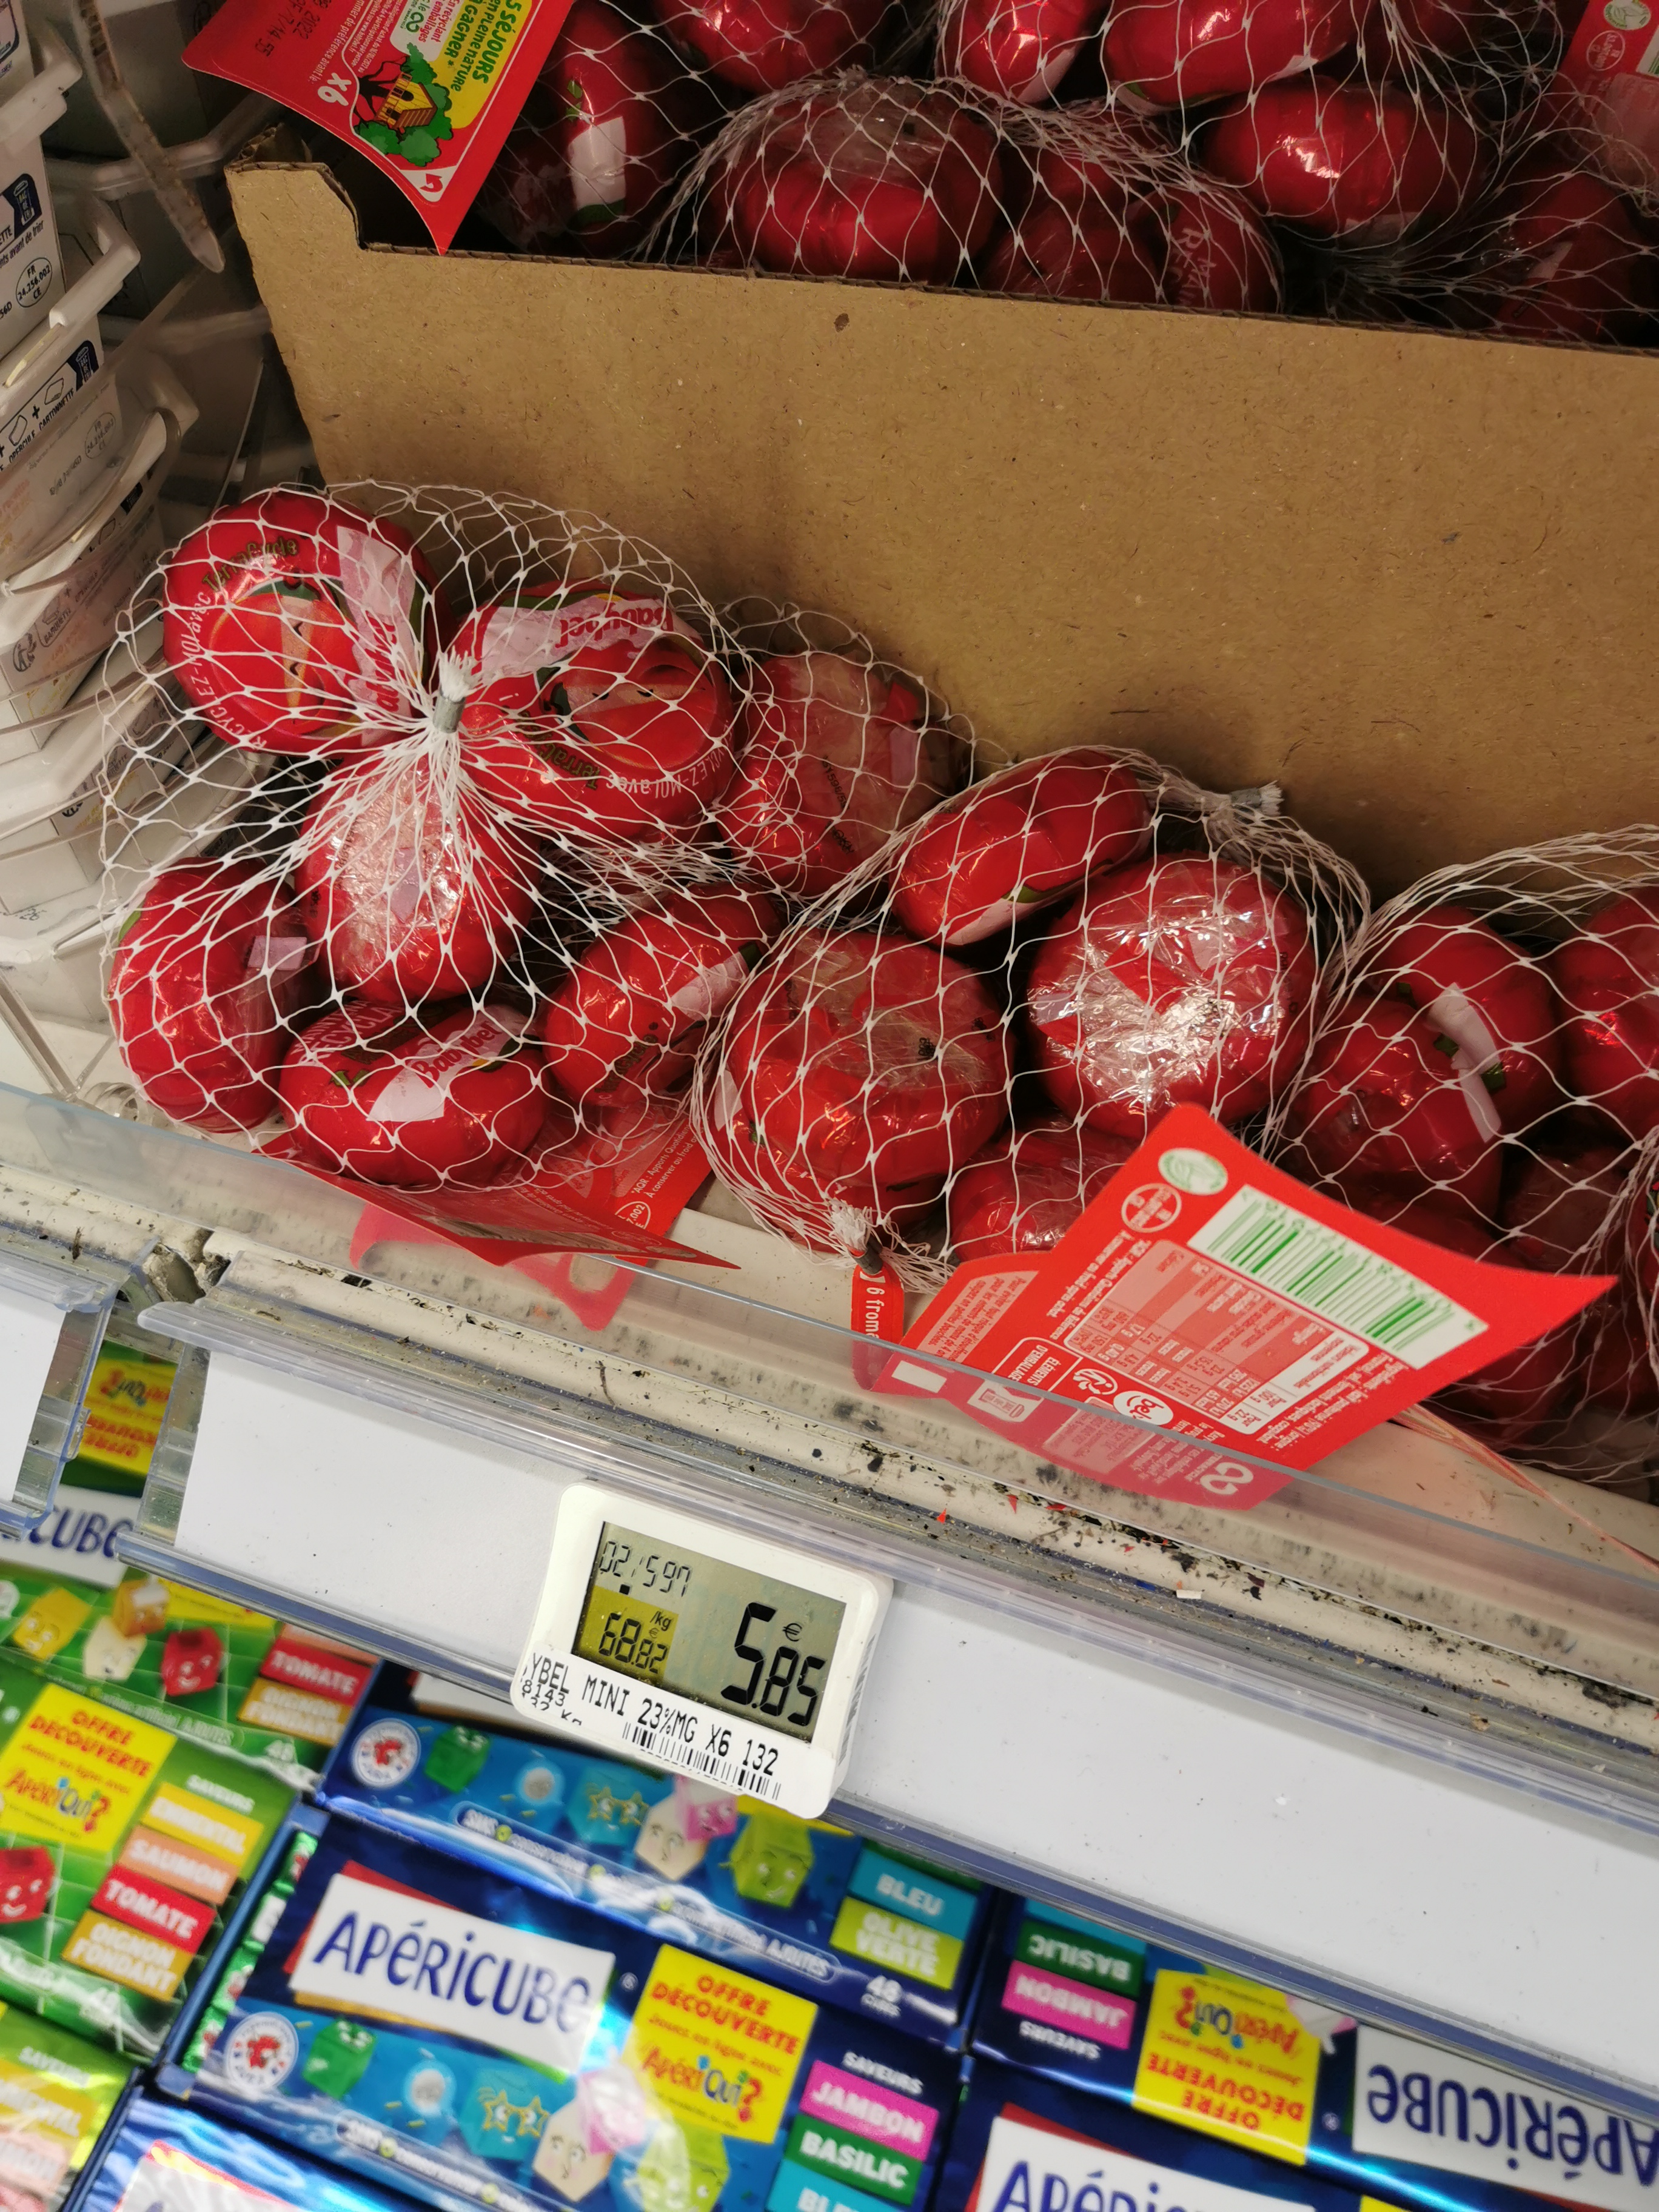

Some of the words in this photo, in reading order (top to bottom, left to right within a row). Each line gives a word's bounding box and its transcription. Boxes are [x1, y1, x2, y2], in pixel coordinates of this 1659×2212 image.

[343, 16, 356, 28] de
[415, 0, 445, 44] emballages
[417, 2, 430, 13] le
[503, 0, 523, 13] 5
[323, 24, 352, 62] préférence
[362, 15, 383, 47] participations
[312, 56, 330, 77] avant
[315, 69, 358, 111] x6
[33, 220, 44, 238] trier
[27, 264, 36, 278] FR
[33, 287, 42, 300] CE
[555, 606, 674, 648] Babybel
[410, 1021, 503, 1089] Babybel
[647, 1153, 669, 1176] Apports
[673, 1156, 682, 1165] au
[676, 1141, 693, 1158] froid
[649, 1164, 676, 1194] conserver
[971, 1318, 990, 1335] risque
[1027, 1356, 1061, 1386] ÉLÉMENTS
[1129, 1397, 1164, 1419] bel
[1235, 1408, 1249, 1419] 22
[1241, 1413, 1261, 1427] Pour
[1267, 1396, 1285, 1409] Pour
[649, 1610, 672, 1632] /kg
[271, 1650, 358, 1695] TOMATE
[720, 1601, 826, 1727] 5.85
[72, 1710, 136, 1746] OFFRE
[582, 1674, 629, 1716] MINI
[638, 1697, 697, 1742] 23%MG
[707, 1723, 730, 1756] X6
[743, 1738, 779, 1775] 132
[28, 1715, 152, 1778] DÉCOUVERTE
[130, 1839, 229, 1891] SAUMON
[107, 1879, 199, 1940] TOMATE
[876, 1872, 945, 1917] BLEU
[90, 1923, 175, 1969] OIGNON
[856, 1929, 939, 1979] VERTE
[861, 1913, 939, 1955] OLIVE
[71, 1939, 176, 1994] FONDANT
[1028, 1934, 1132, 1983] BASILIC
[696, 1974, 771, 2017] OFFRE
[866, 1975, 903, 2003] 48
[1014, 1975, 1128, 2029] JAMBON
[651, 1980, 800, 2056] DÉCOUVERTE
[1019, 2020, 1102, 2060] SAVEURS
[842, 2051, 924, 2096] SAVEURS
[1147, 2053, 1305, 2123] DÉCOUVERTE
[812, 2080, 925, 2143] JAMBON
[1182, 2090, 1259, 2131] OFFRE
[800, 2129, 908, 2190] BASILIC
